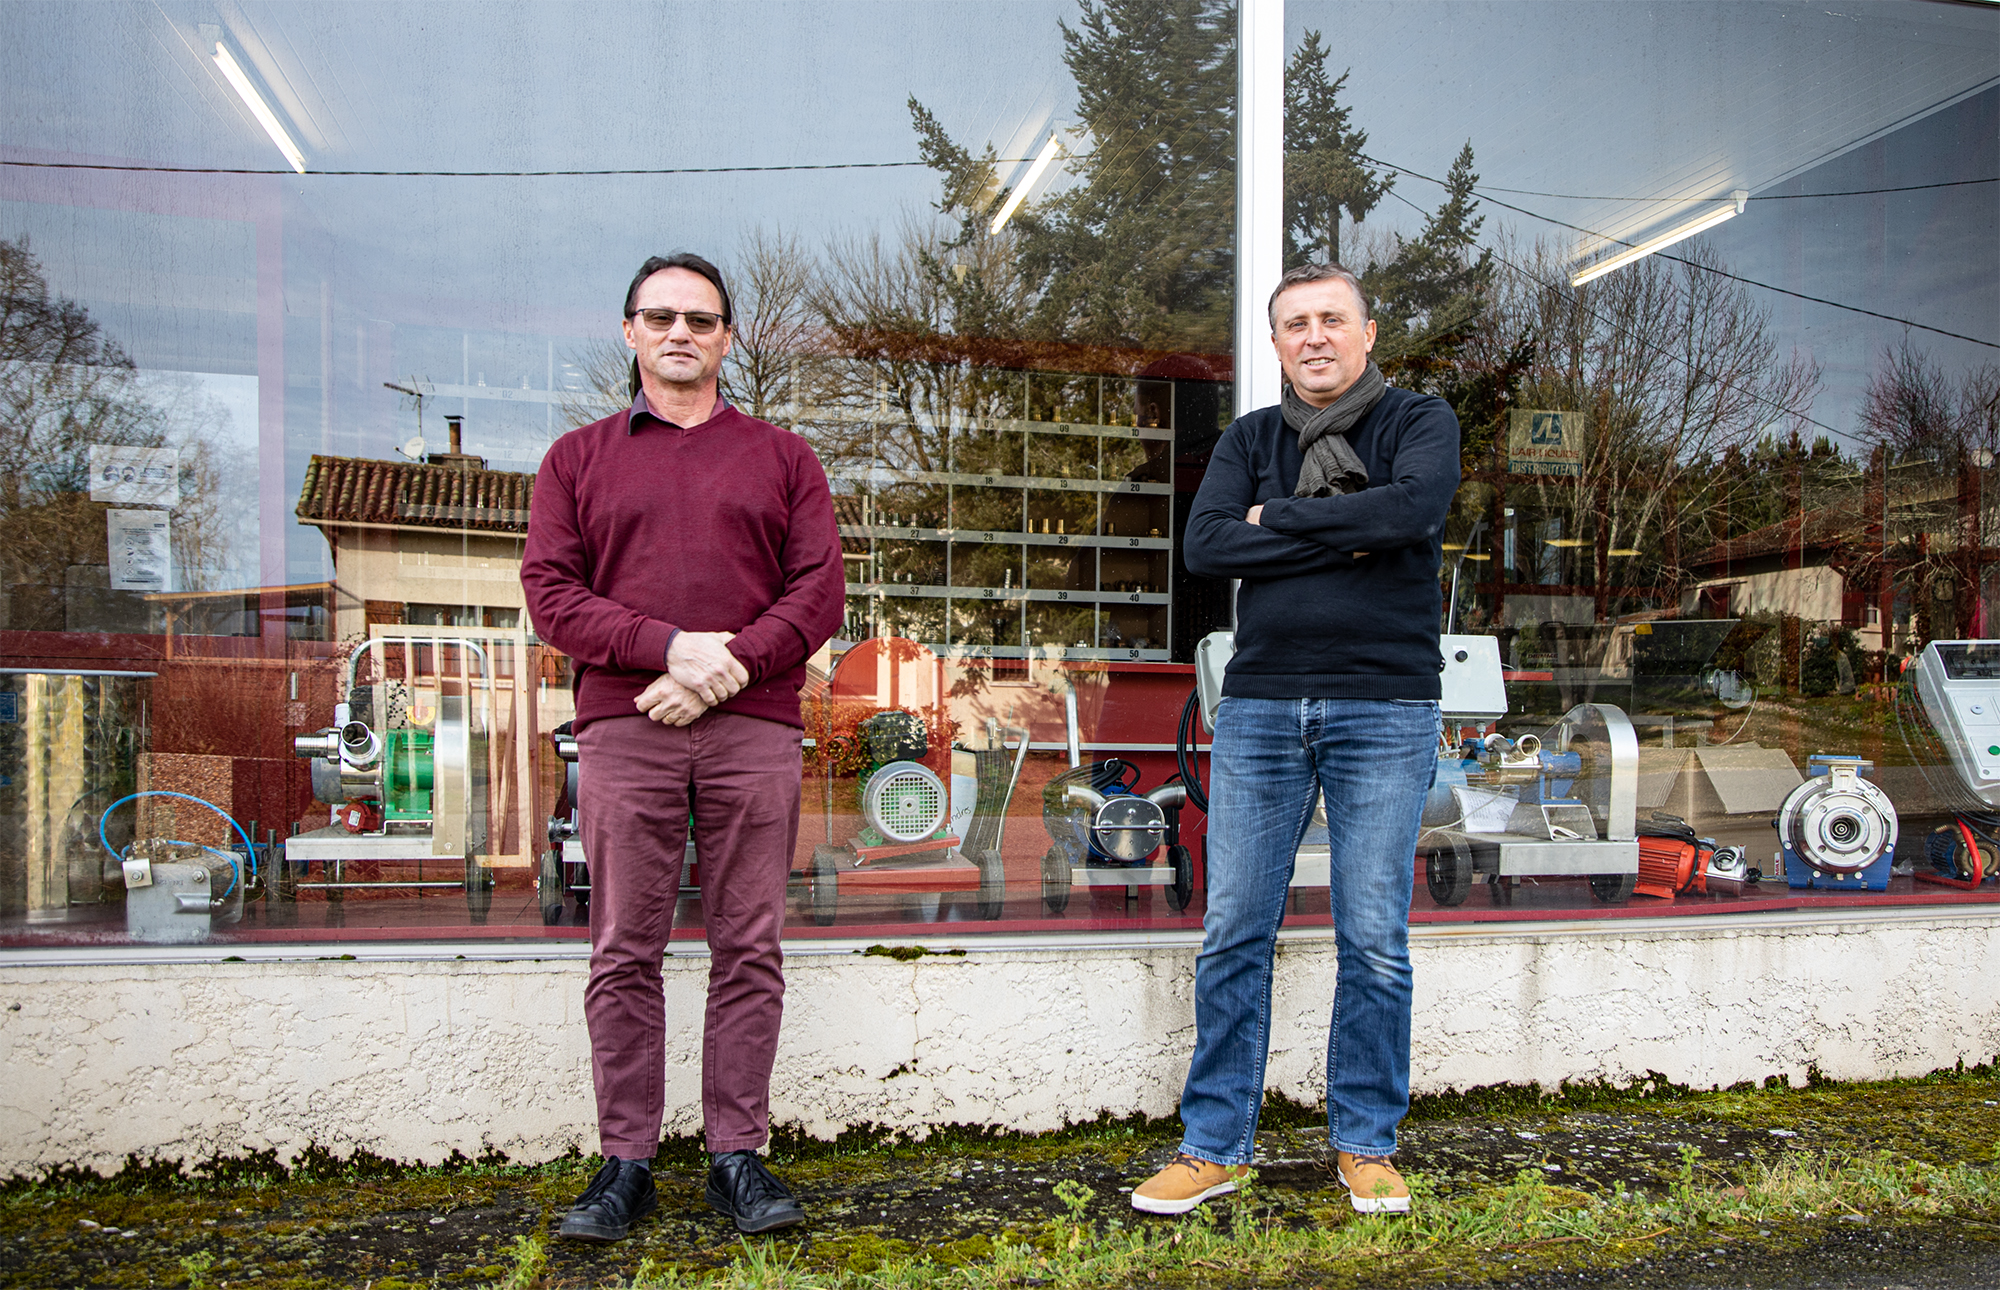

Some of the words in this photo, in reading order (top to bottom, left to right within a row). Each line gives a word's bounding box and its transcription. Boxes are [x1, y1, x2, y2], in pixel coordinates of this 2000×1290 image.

[1059, 424, 1069, 433] 09
[1131, 428, 1139, 437] 10
[1511, 447, 1536, 457] L'AIR
[1539, 449, 1580, 459] LIQUIDE
[1511, 461, 1579, 476] DISTRIBUTEUR
[985, 476, 993, 485] 18
[1060, 480, 1068, 488] 19
[1130, 484, 1140, 492] 20
[427, 506, 436, 516] 21
[910, 529, 920, 538] 27
[983, 532, 993, 541] 28
[1058, 535, 1068, 544] 29
[1129, 538, 1139, 547] 30
[910, 586, 920, 595] 37
[983, 588, 993, 597] 38
[1057, 591, 1067, 600] 39
[1129, 594, 1139, 603] 40
[1129, 649, 1139, 658] 50
[951, 806, 972, 821] ndres
